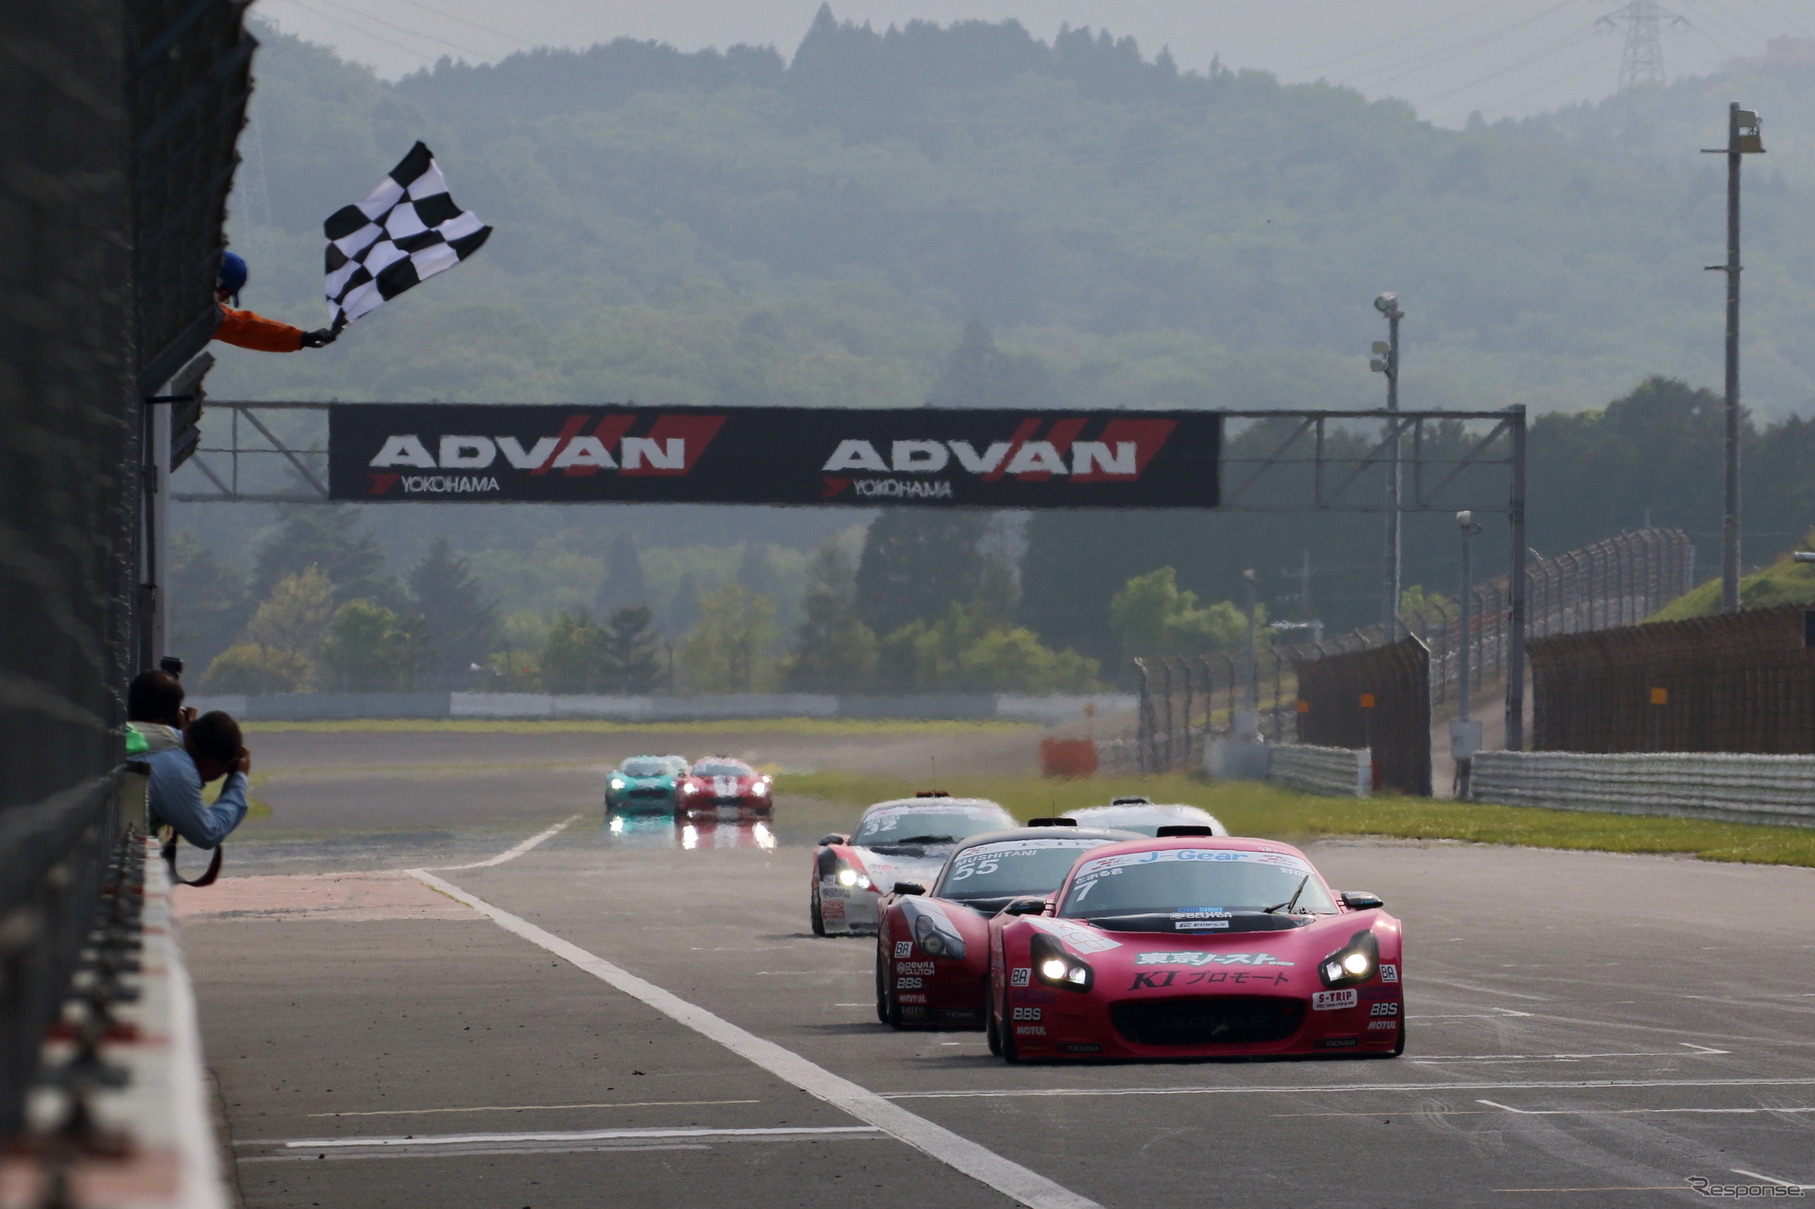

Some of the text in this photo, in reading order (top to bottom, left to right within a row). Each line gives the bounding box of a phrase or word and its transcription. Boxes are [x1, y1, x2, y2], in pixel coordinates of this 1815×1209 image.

[369, 435, 685, 469] ADVAN
[822, 439, 1137, 474] ADVAN
[402, 475, 499, 493] YOKOHAMA
[853, 479, 953, 498] YOKOHAMA
[955, 850, 1038, 867] MUSHITANI
[1139, 849, 1249, 863] J-Gear
[953, 858, 1000, 881] 55
[1073, 879, 1098, 903] 7
[896, 943, 909, 955] BA
[905, 961, 935, 969] OGURA
[1012, 969, 1028, 983] BA
[1380, 966, 1396, 979] BA
[897, 977, 923, 989] BBS
[1128, 969, 1290, 991] KI プロモート
[899, 994, 927, 1003] MOTUL
[1318, 991, 1352, 1003] S-TRIP
[1013, 1007, 1042, 1021] BBS
[1370, 1002, 1398, 1016] BBS
[1016, 1025, 1047, 1036] MOTUL
[1367, 1020, 1397, 1030] MOTUL
